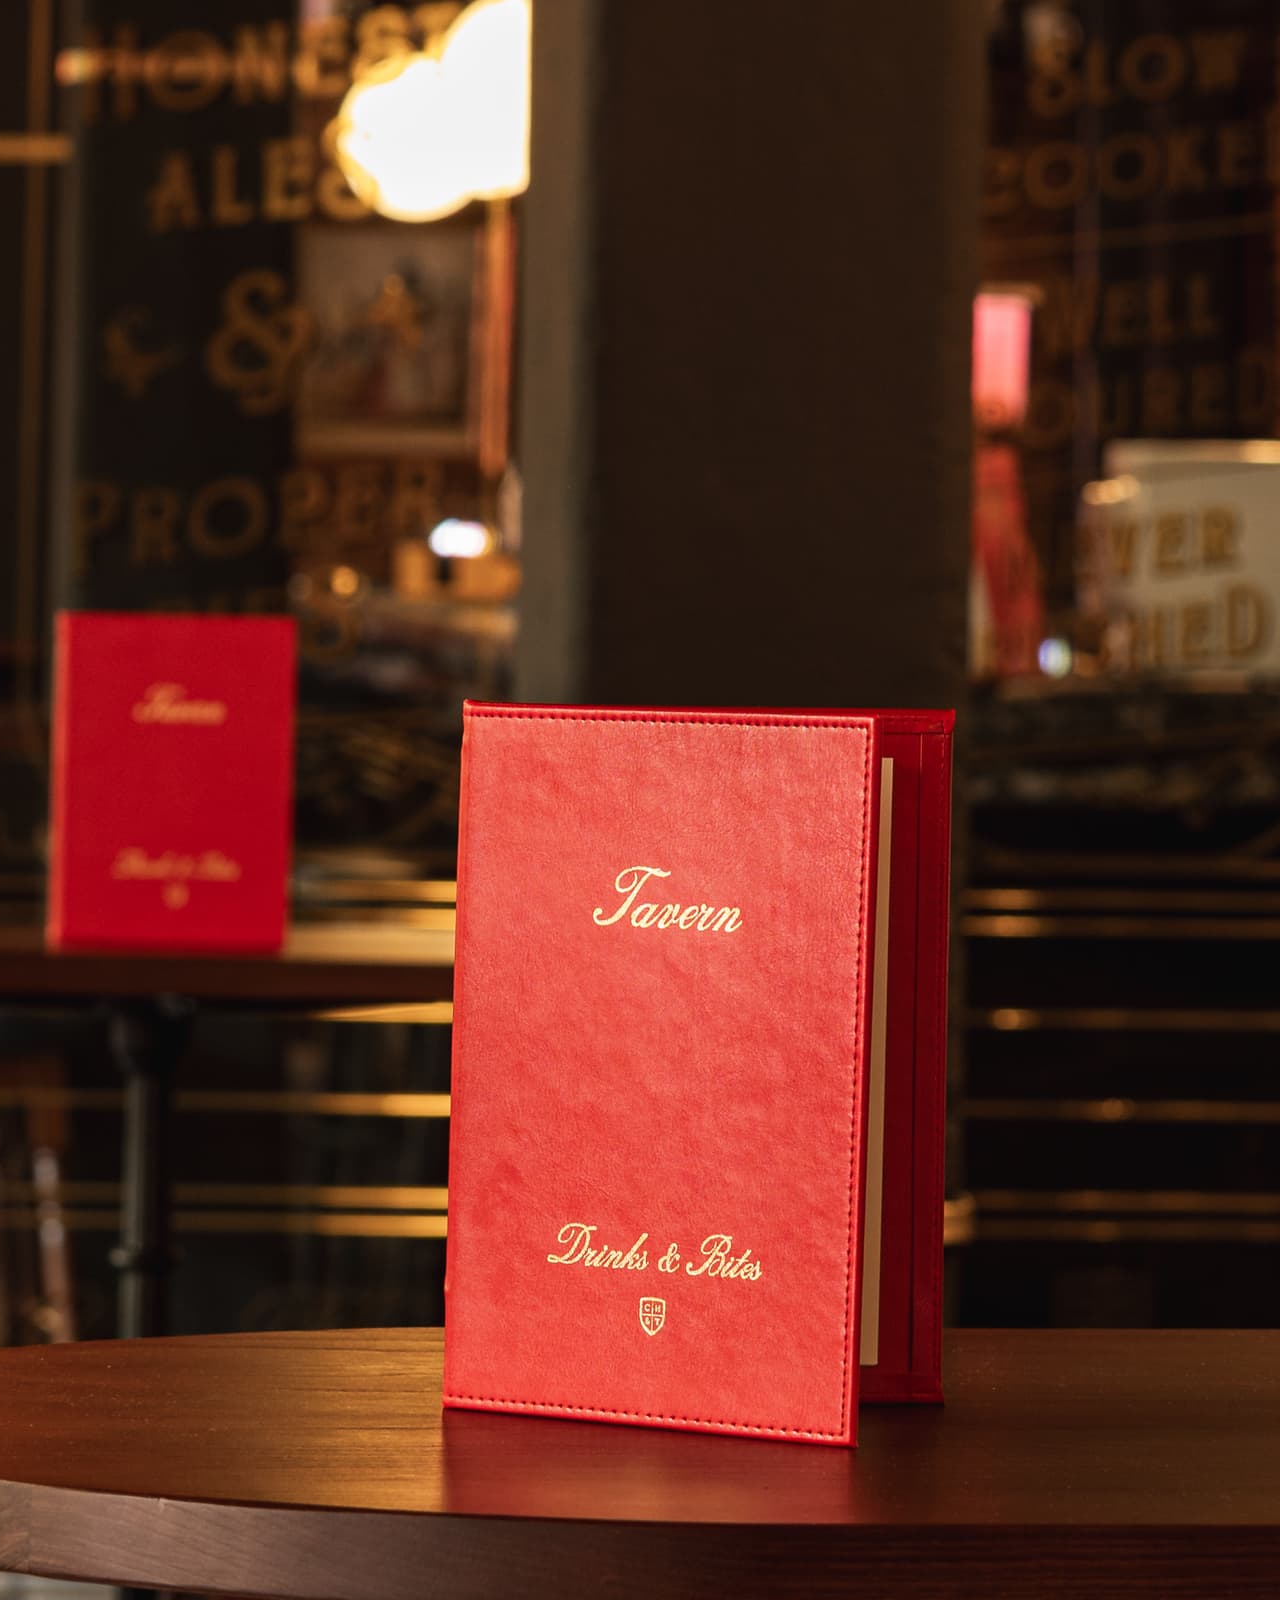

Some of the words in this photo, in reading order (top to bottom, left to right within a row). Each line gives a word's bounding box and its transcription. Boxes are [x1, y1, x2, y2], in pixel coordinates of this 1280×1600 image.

[592, 865, 743, 933] Tavern
[547, 1222, 650, 1271] Drinks
[657, 1242, 682, 1273] &
[685, 1233, 763, 1282] Bites
